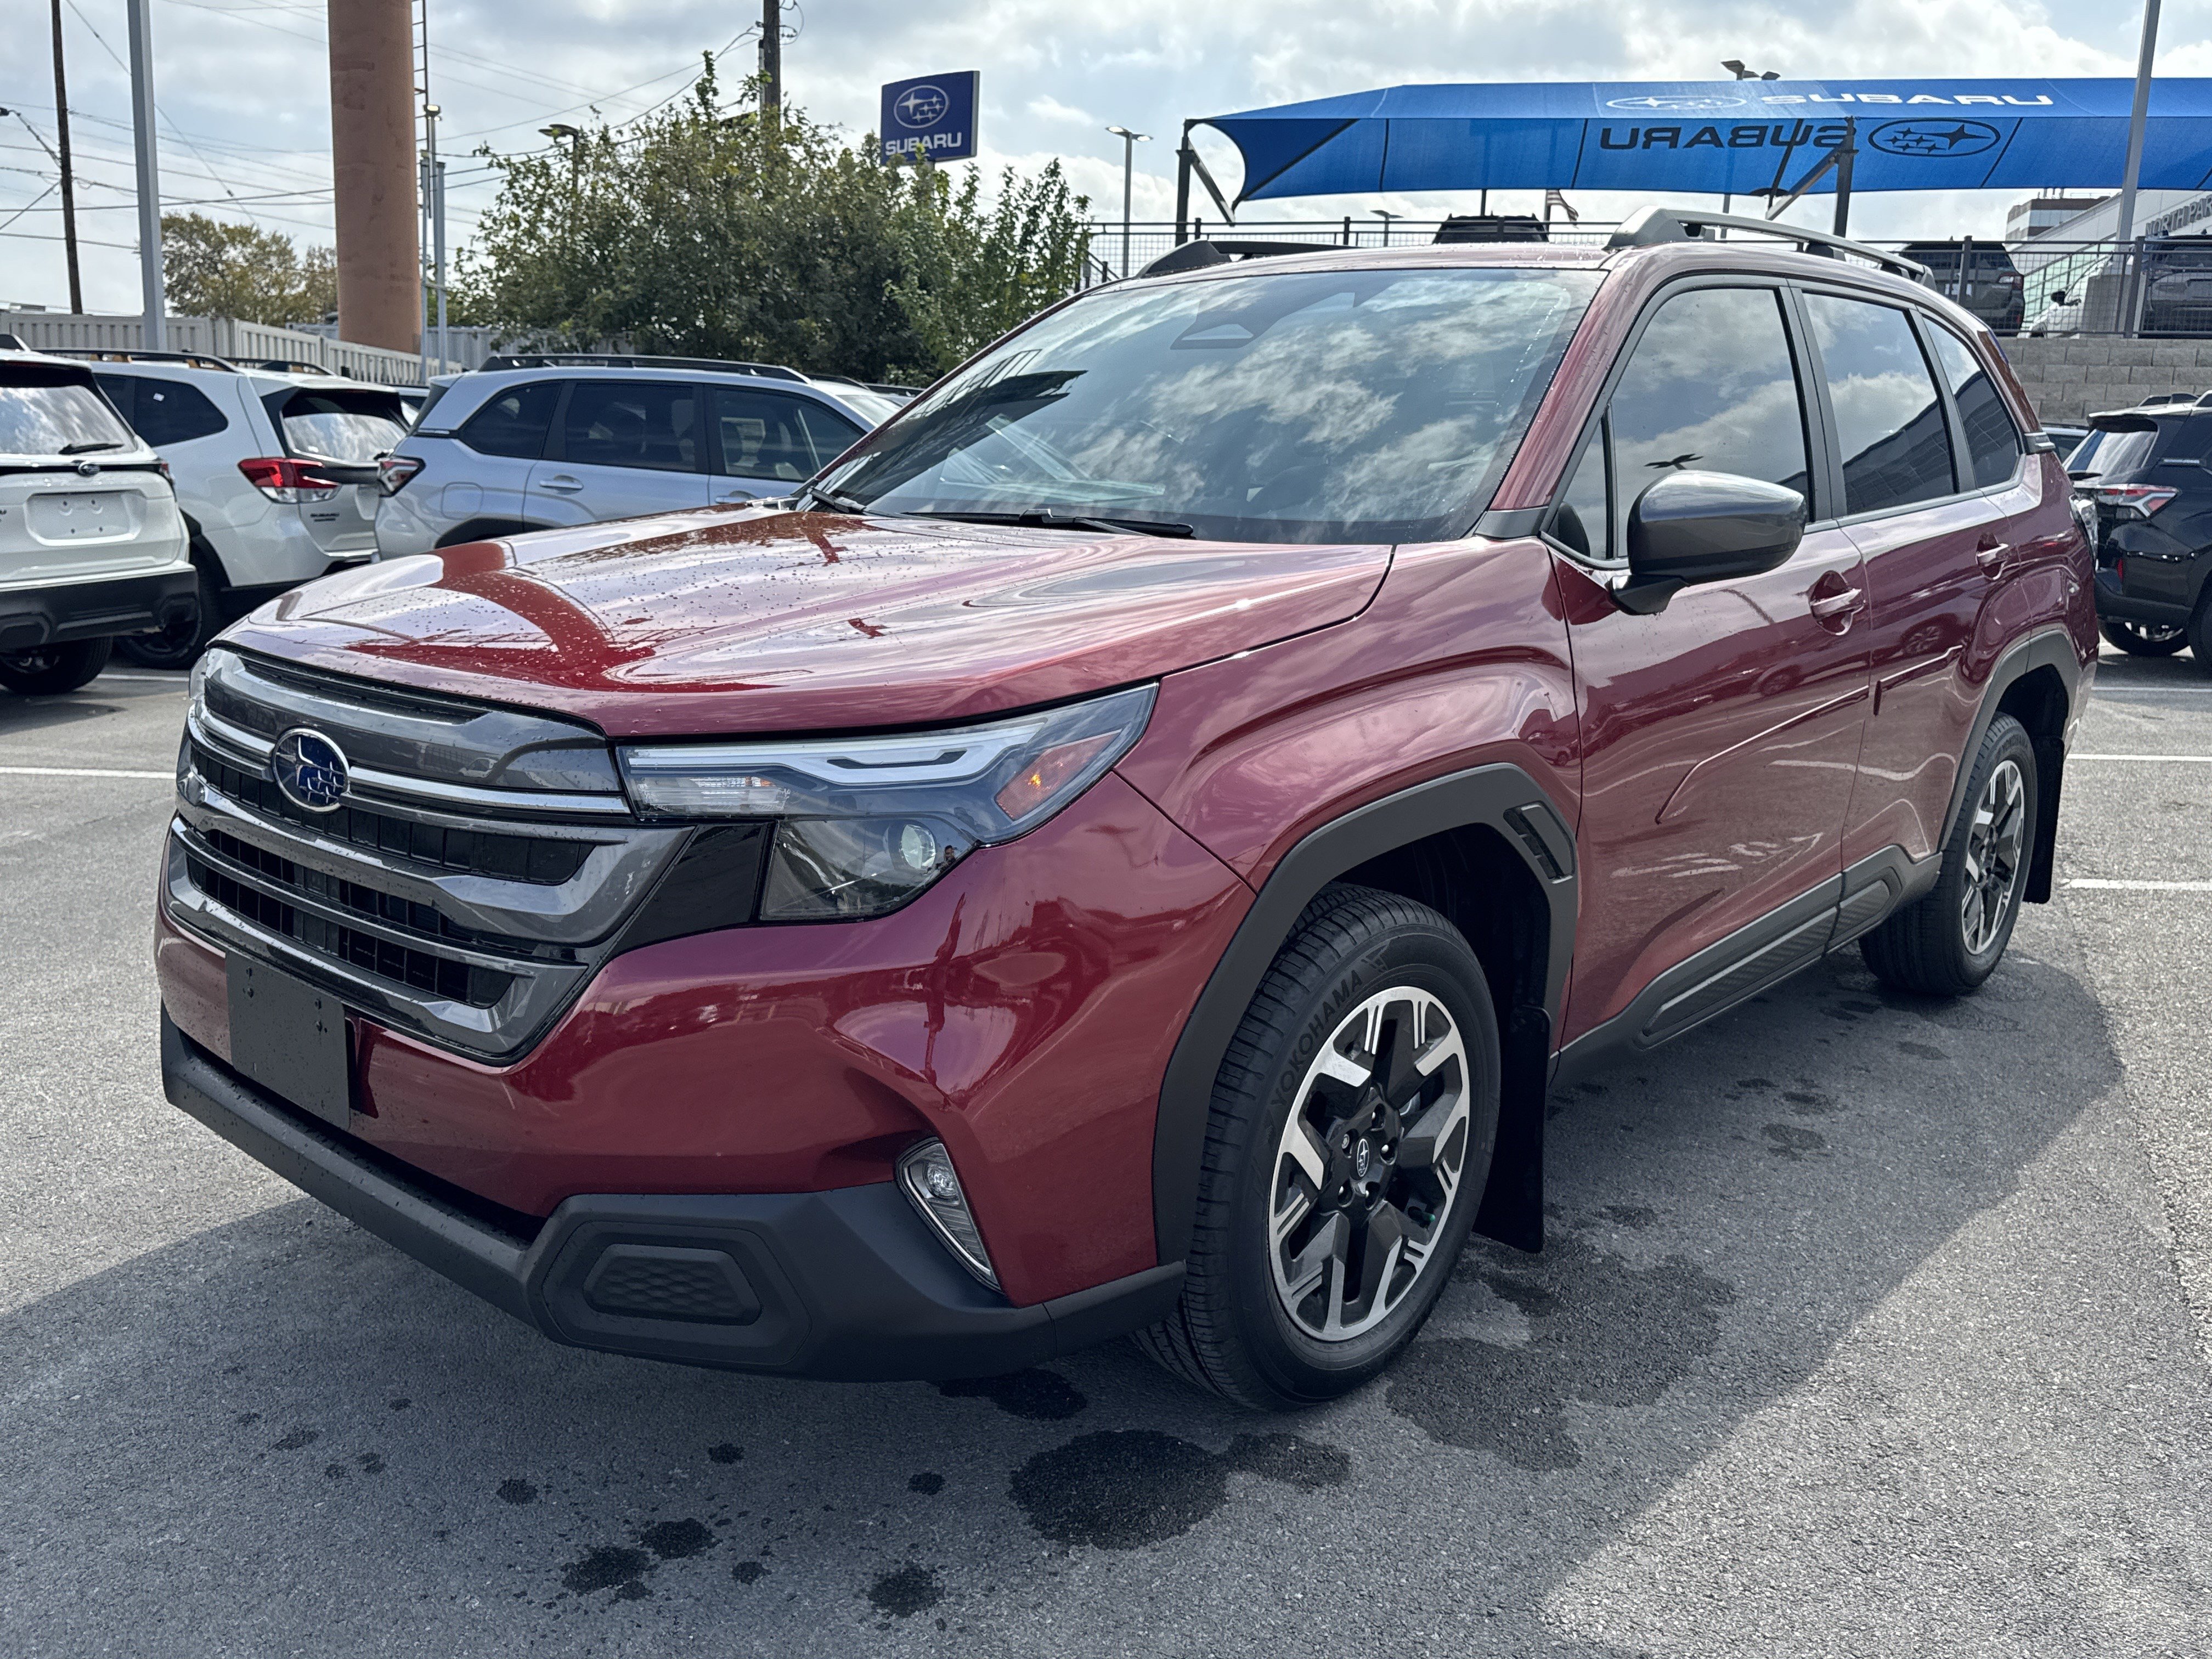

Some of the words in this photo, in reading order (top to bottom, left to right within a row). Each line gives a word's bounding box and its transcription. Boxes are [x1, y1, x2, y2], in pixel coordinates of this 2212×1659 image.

[1760, 93, 2053, 105] SUBARU
[885, 132, 962, 156] SUBARU
[2145, 206, 2189, 236] NORTH
[1271, 969, 1363, 1106] YOKOHAMA
